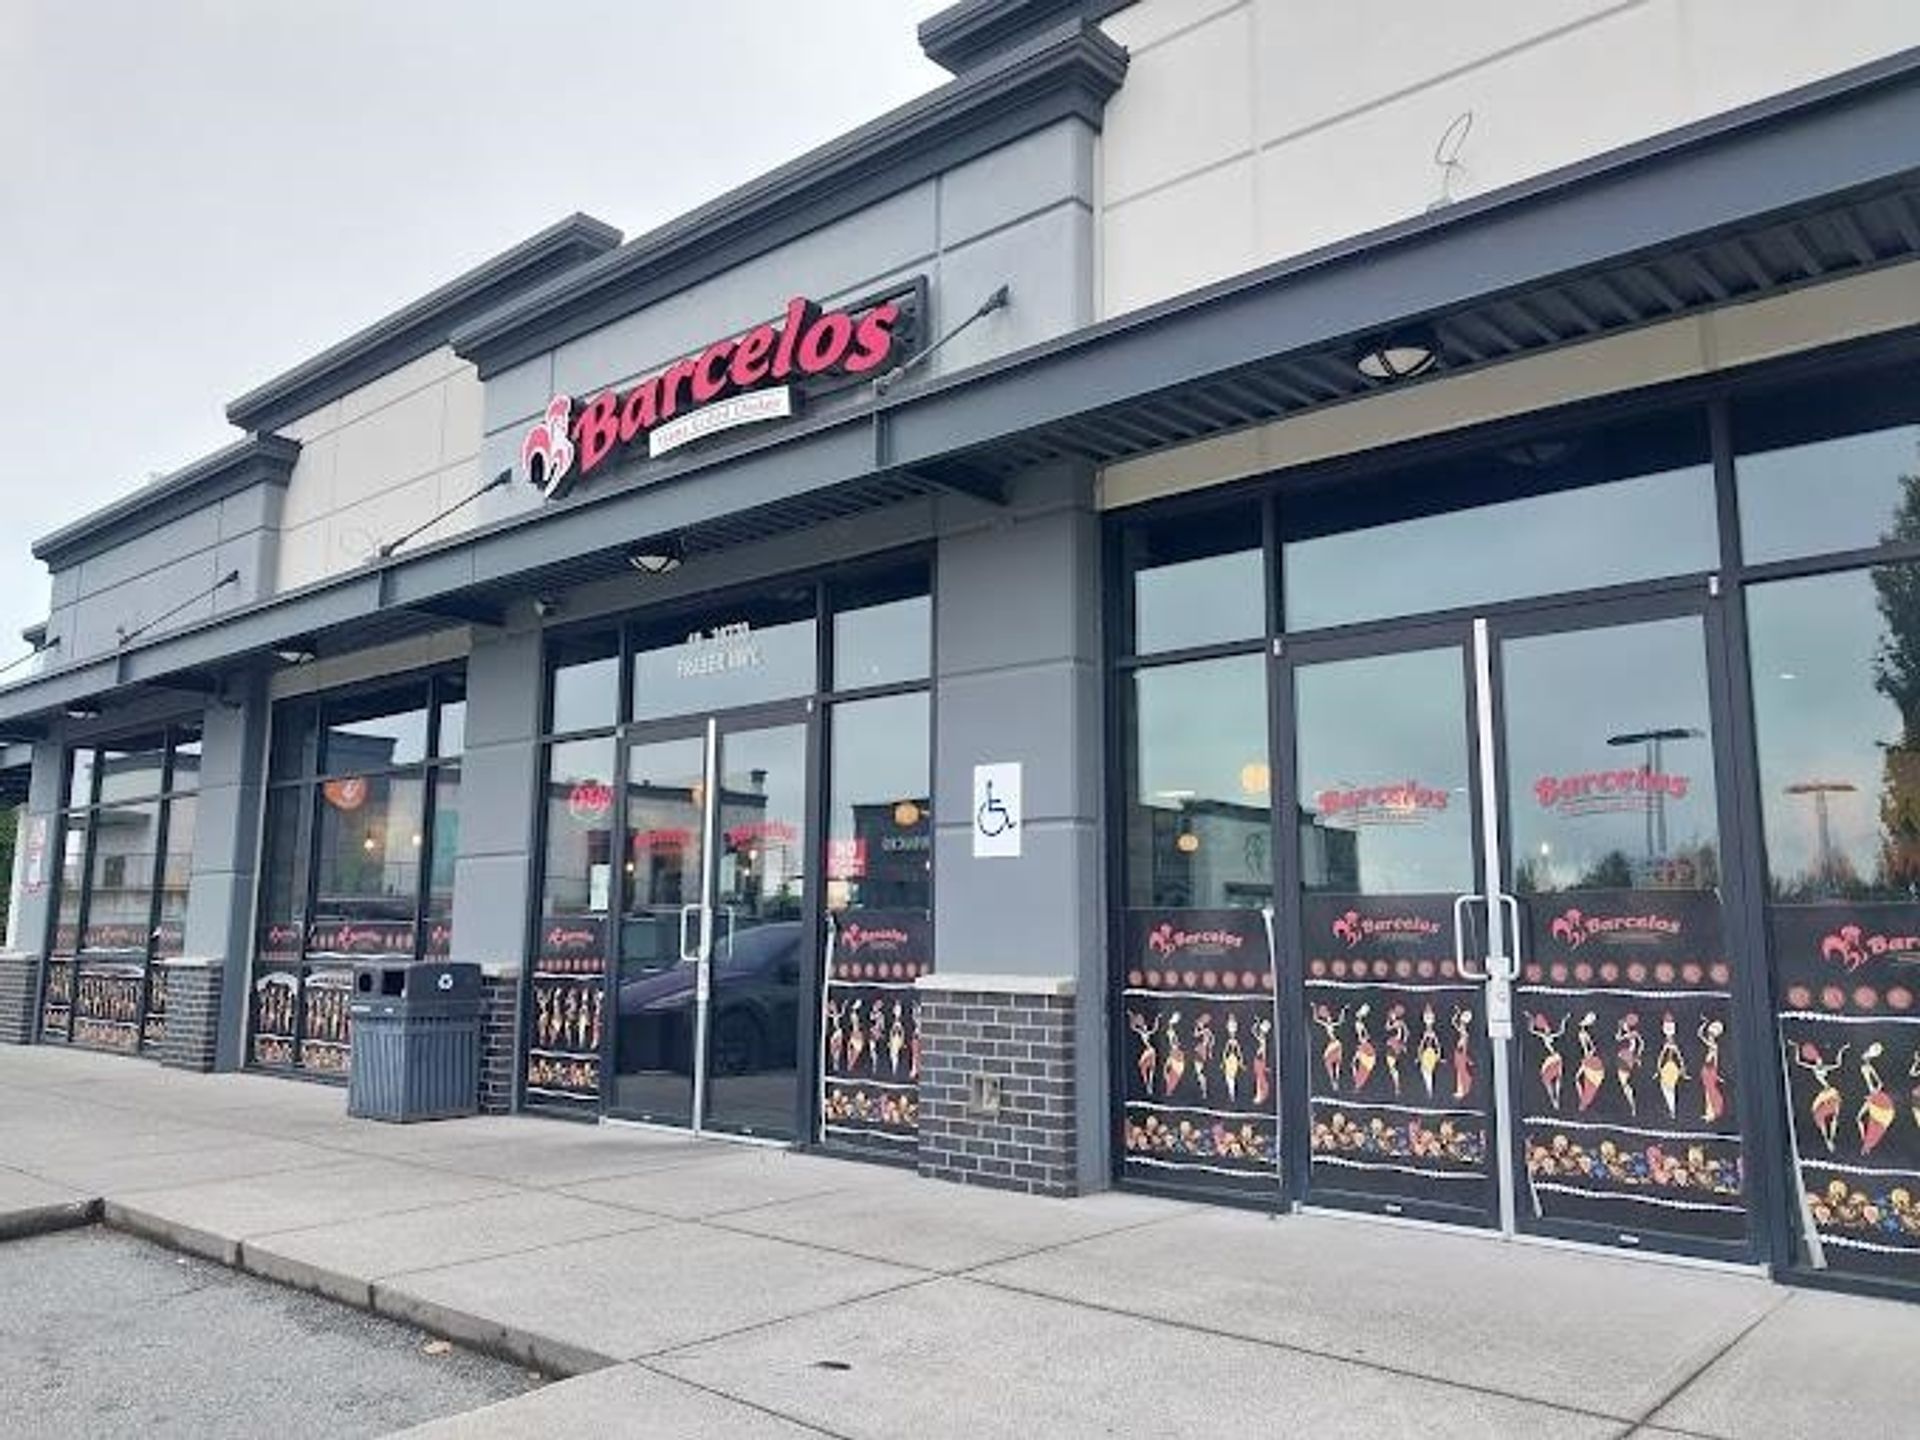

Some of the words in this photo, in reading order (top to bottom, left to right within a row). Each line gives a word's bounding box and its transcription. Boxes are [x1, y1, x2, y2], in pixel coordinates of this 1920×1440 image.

[573, 297, 898, 473] Barcelos
[1360, 914, 1441, 934] Barcelos
[1583, 914, 1681, 934] Barcelos
